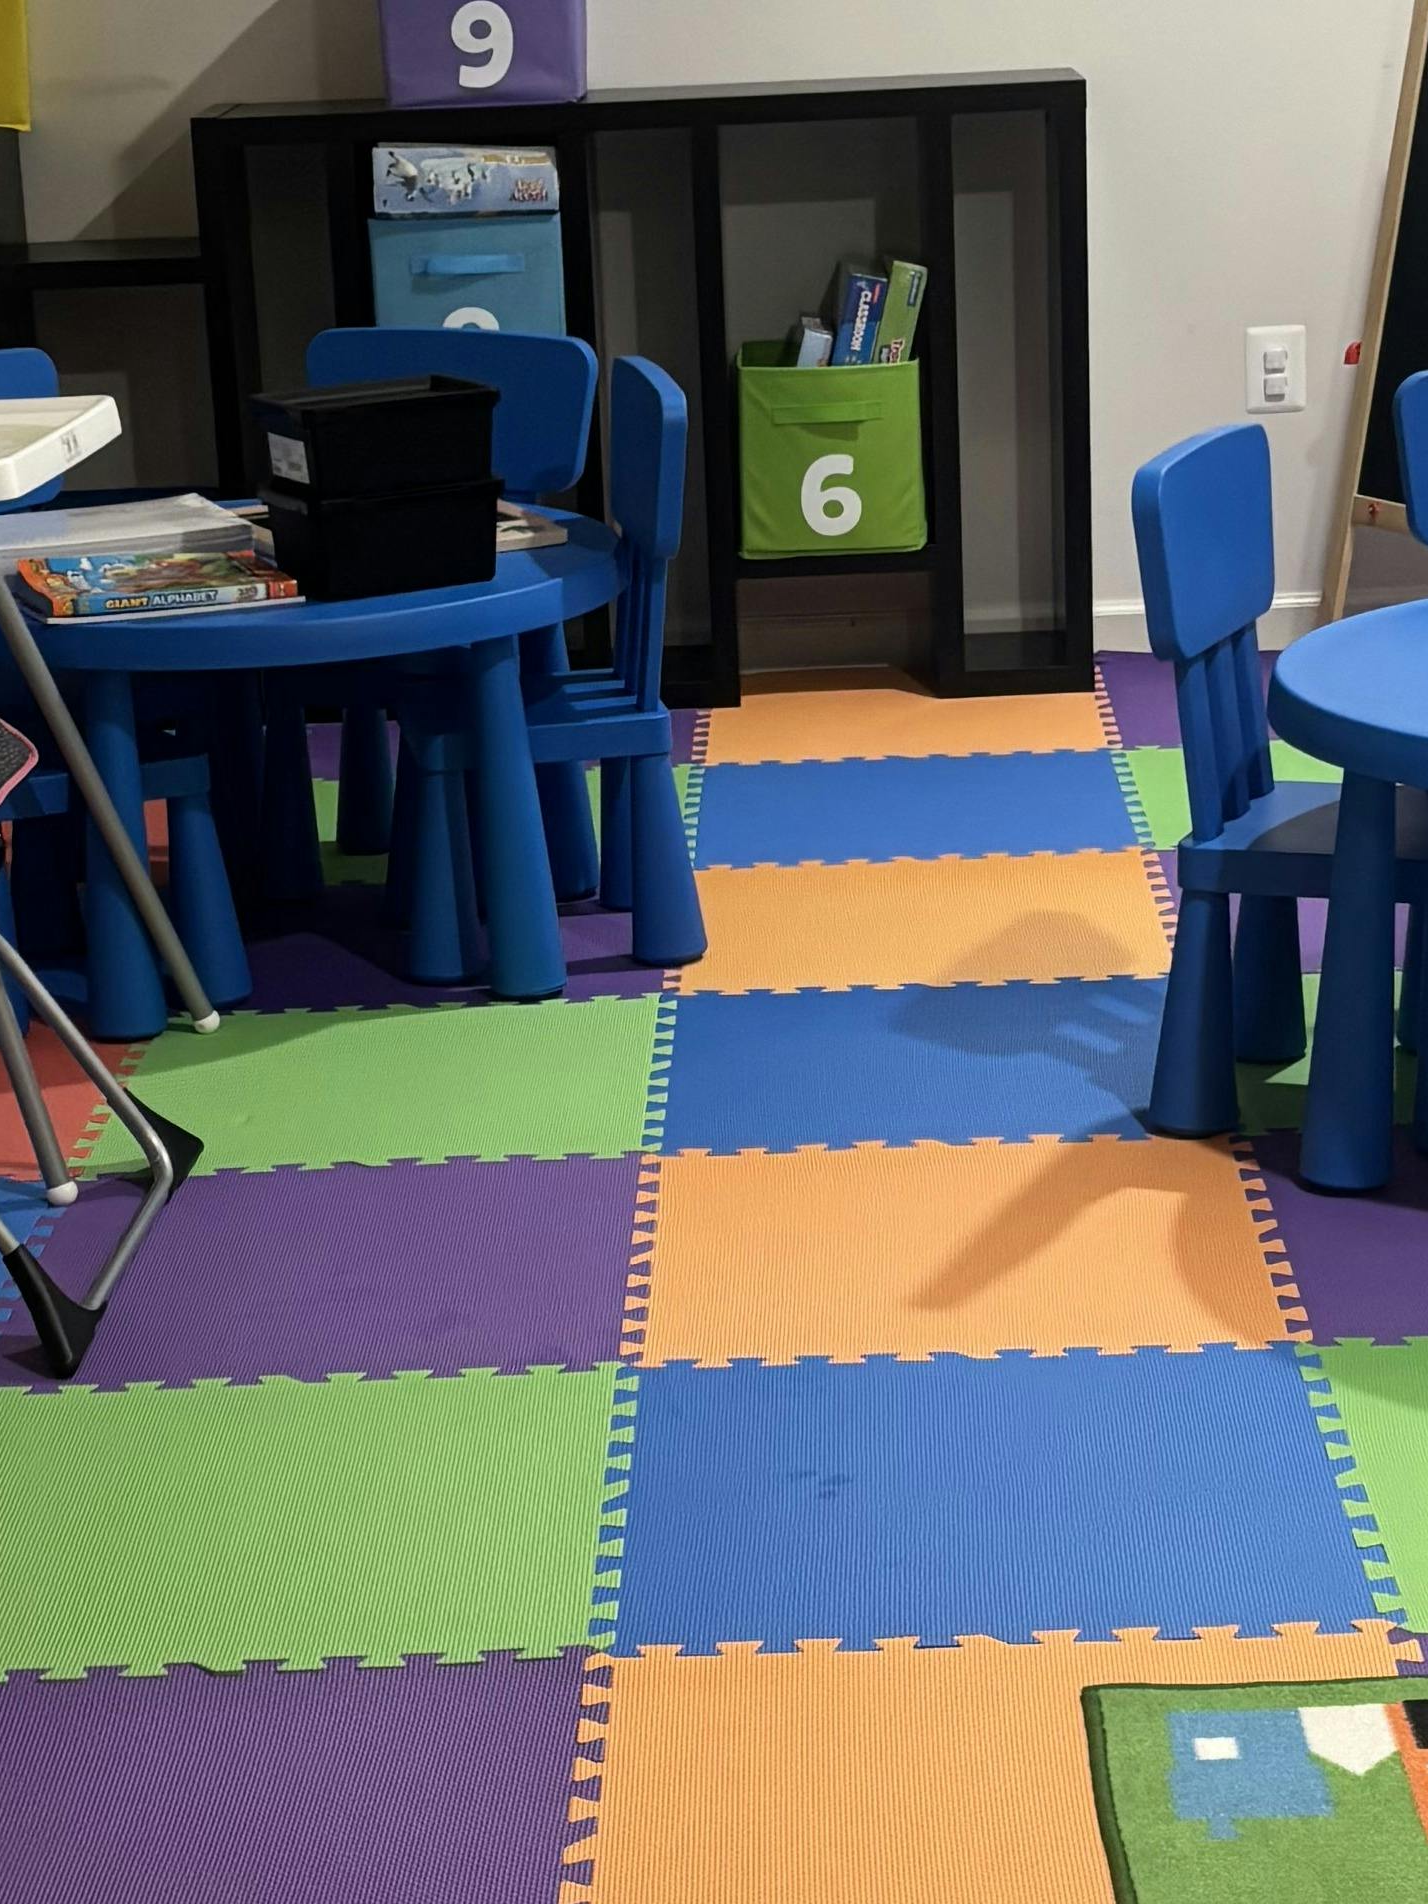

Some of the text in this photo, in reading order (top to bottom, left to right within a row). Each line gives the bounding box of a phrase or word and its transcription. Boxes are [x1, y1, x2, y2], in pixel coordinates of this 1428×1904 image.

[450, 0, 513, 89] 9
[801, 454, 862, 536] 6
[105, 598, 149, 609] GIANT
[152, 590, 218, 607] ALPHABET
